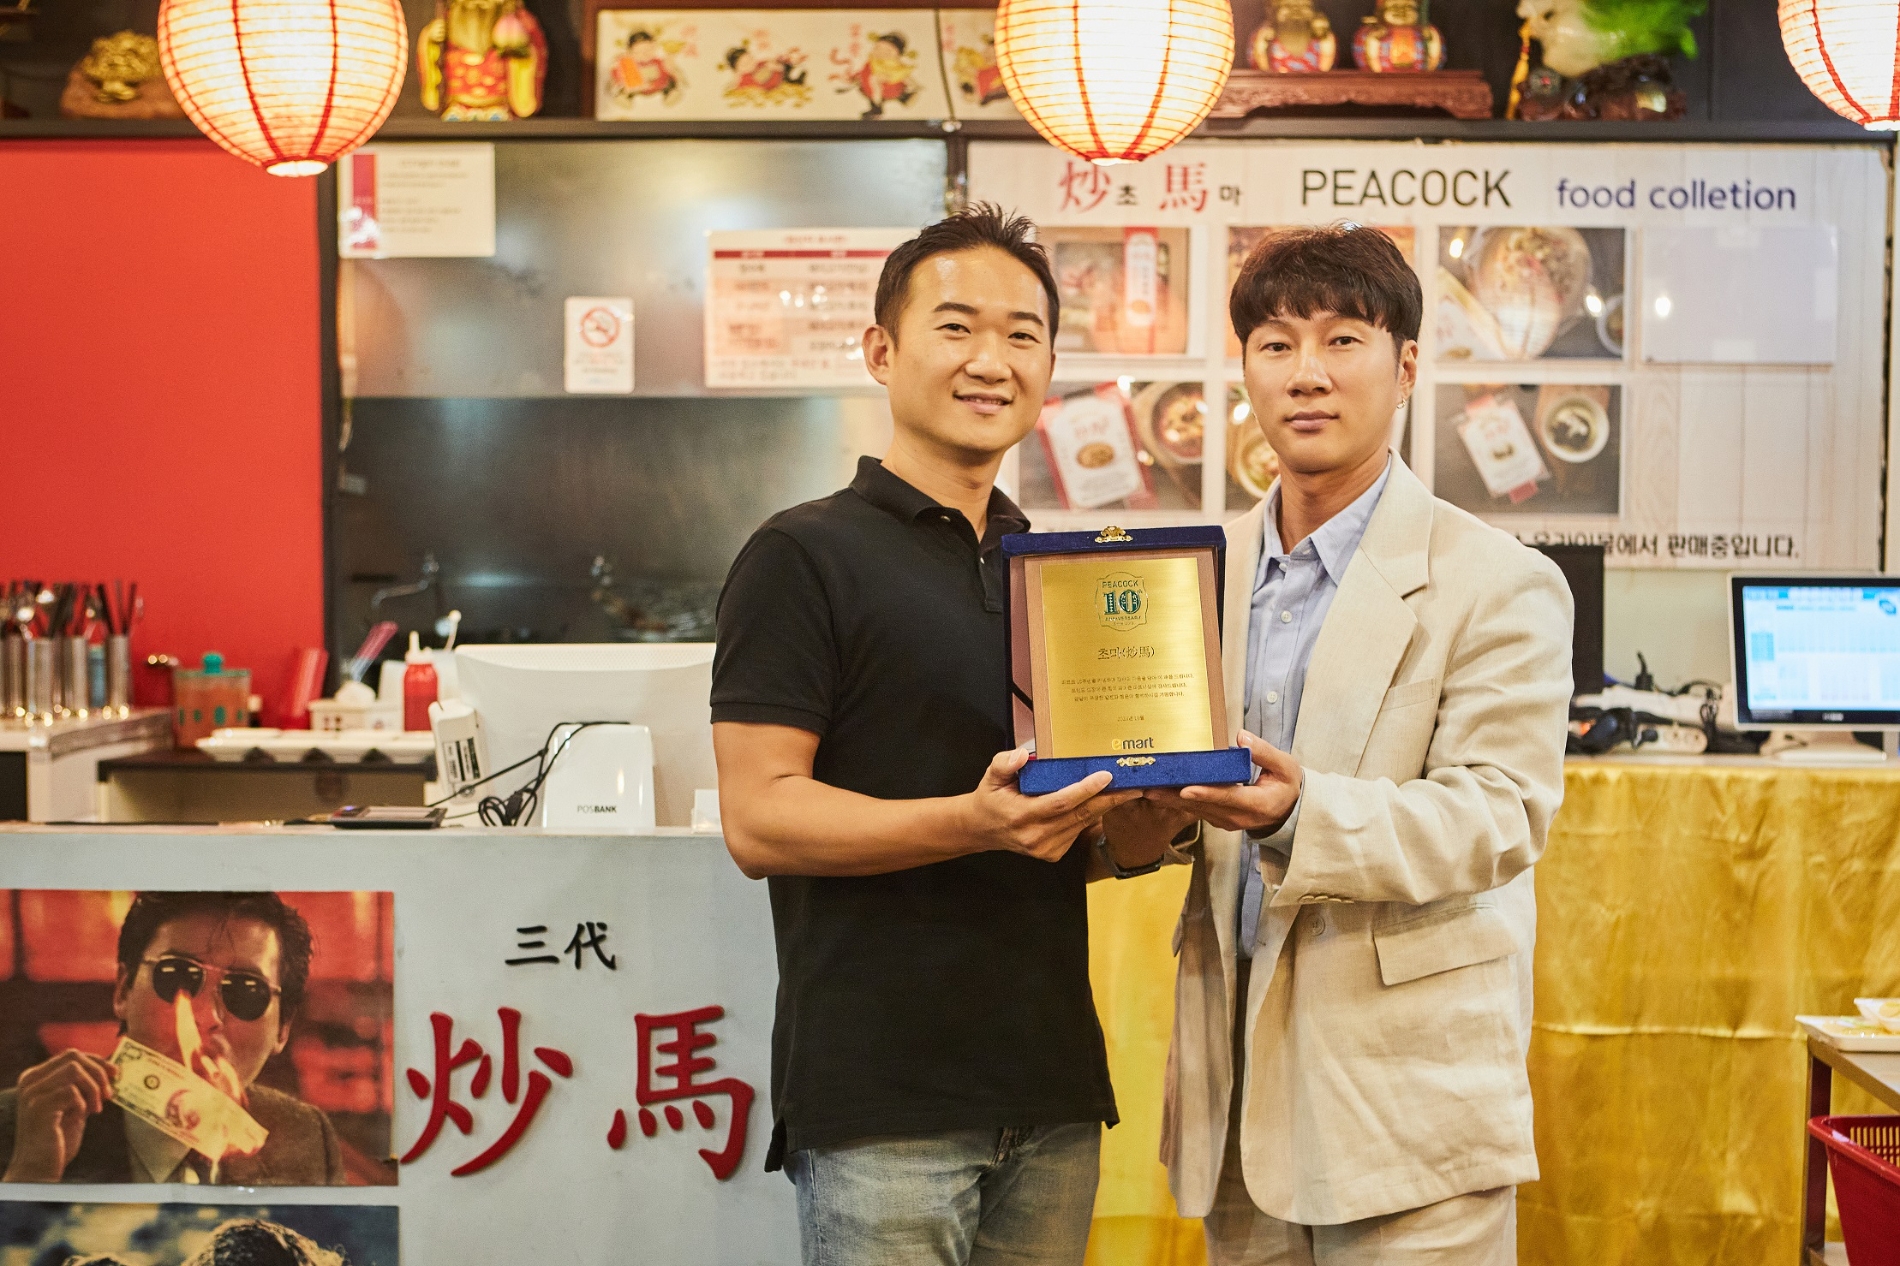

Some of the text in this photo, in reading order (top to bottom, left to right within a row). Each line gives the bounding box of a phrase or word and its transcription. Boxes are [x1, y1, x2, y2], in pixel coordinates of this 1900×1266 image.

[1058, 160, 1242, 213] 炒 초 馬 마
[1302, 169, 1797, 210] PEACOCK food colletion
[1102, 580, 1139, 589] PEACOCK
[1111, 737, 1154, 750] emart
[577, 805, 617, 814] POSBANK
[504, 921, 617, 971] 三代
